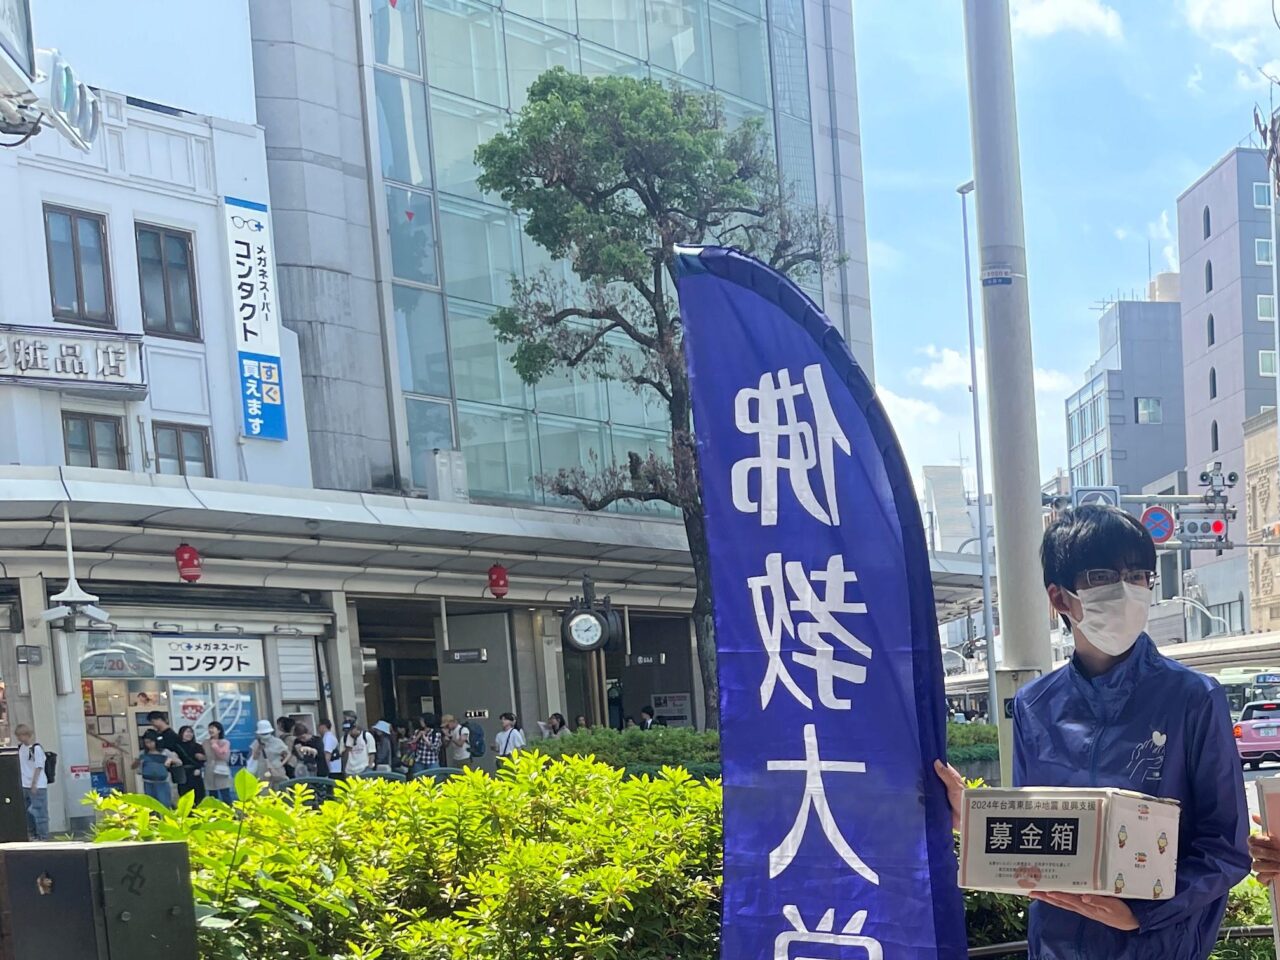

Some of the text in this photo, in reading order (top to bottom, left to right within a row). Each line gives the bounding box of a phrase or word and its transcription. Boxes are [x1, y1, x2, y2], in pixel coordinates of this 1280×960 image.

[234, 239, 259, 343] コンタクト
[256, 244, 271, 322] メガネスーパー
[242, 359, 264, 435] 買えます
[262, 364, 280, 402] すぐ
[169, 656, 251, 672] コンタクト
[195, 642, 249, 652] メガネスーパー
[989, 821, 1076, 852] 募金箱
